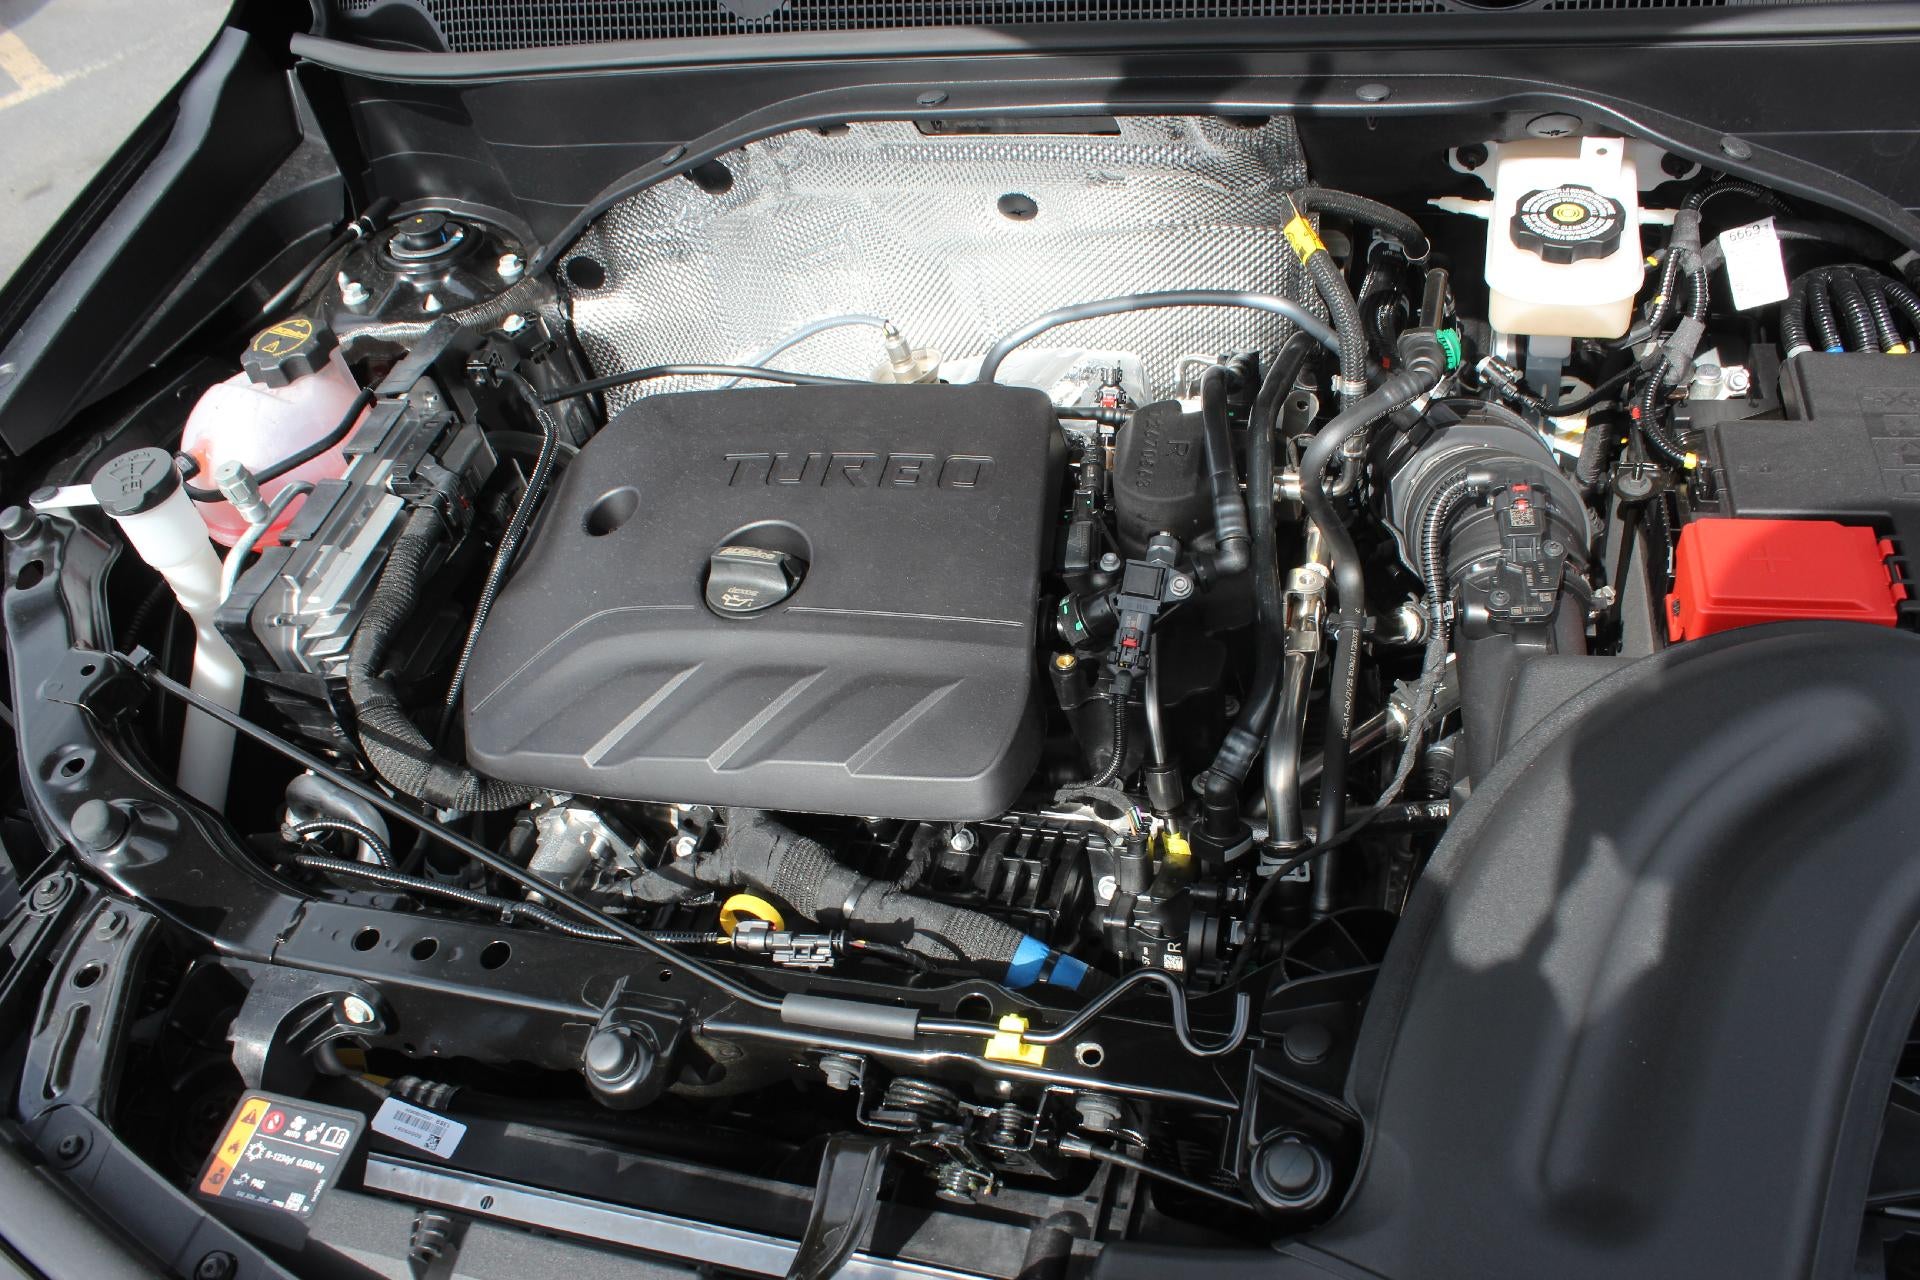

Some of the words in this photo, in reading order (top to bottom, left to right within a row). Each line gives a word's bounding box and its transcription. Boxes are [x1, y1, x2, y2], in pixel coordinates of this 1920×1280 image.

[723, 452, 995, 488] TURBO
[1167, 942, 1182, 953] R
[249, 1178, 266, 1190] PAG
